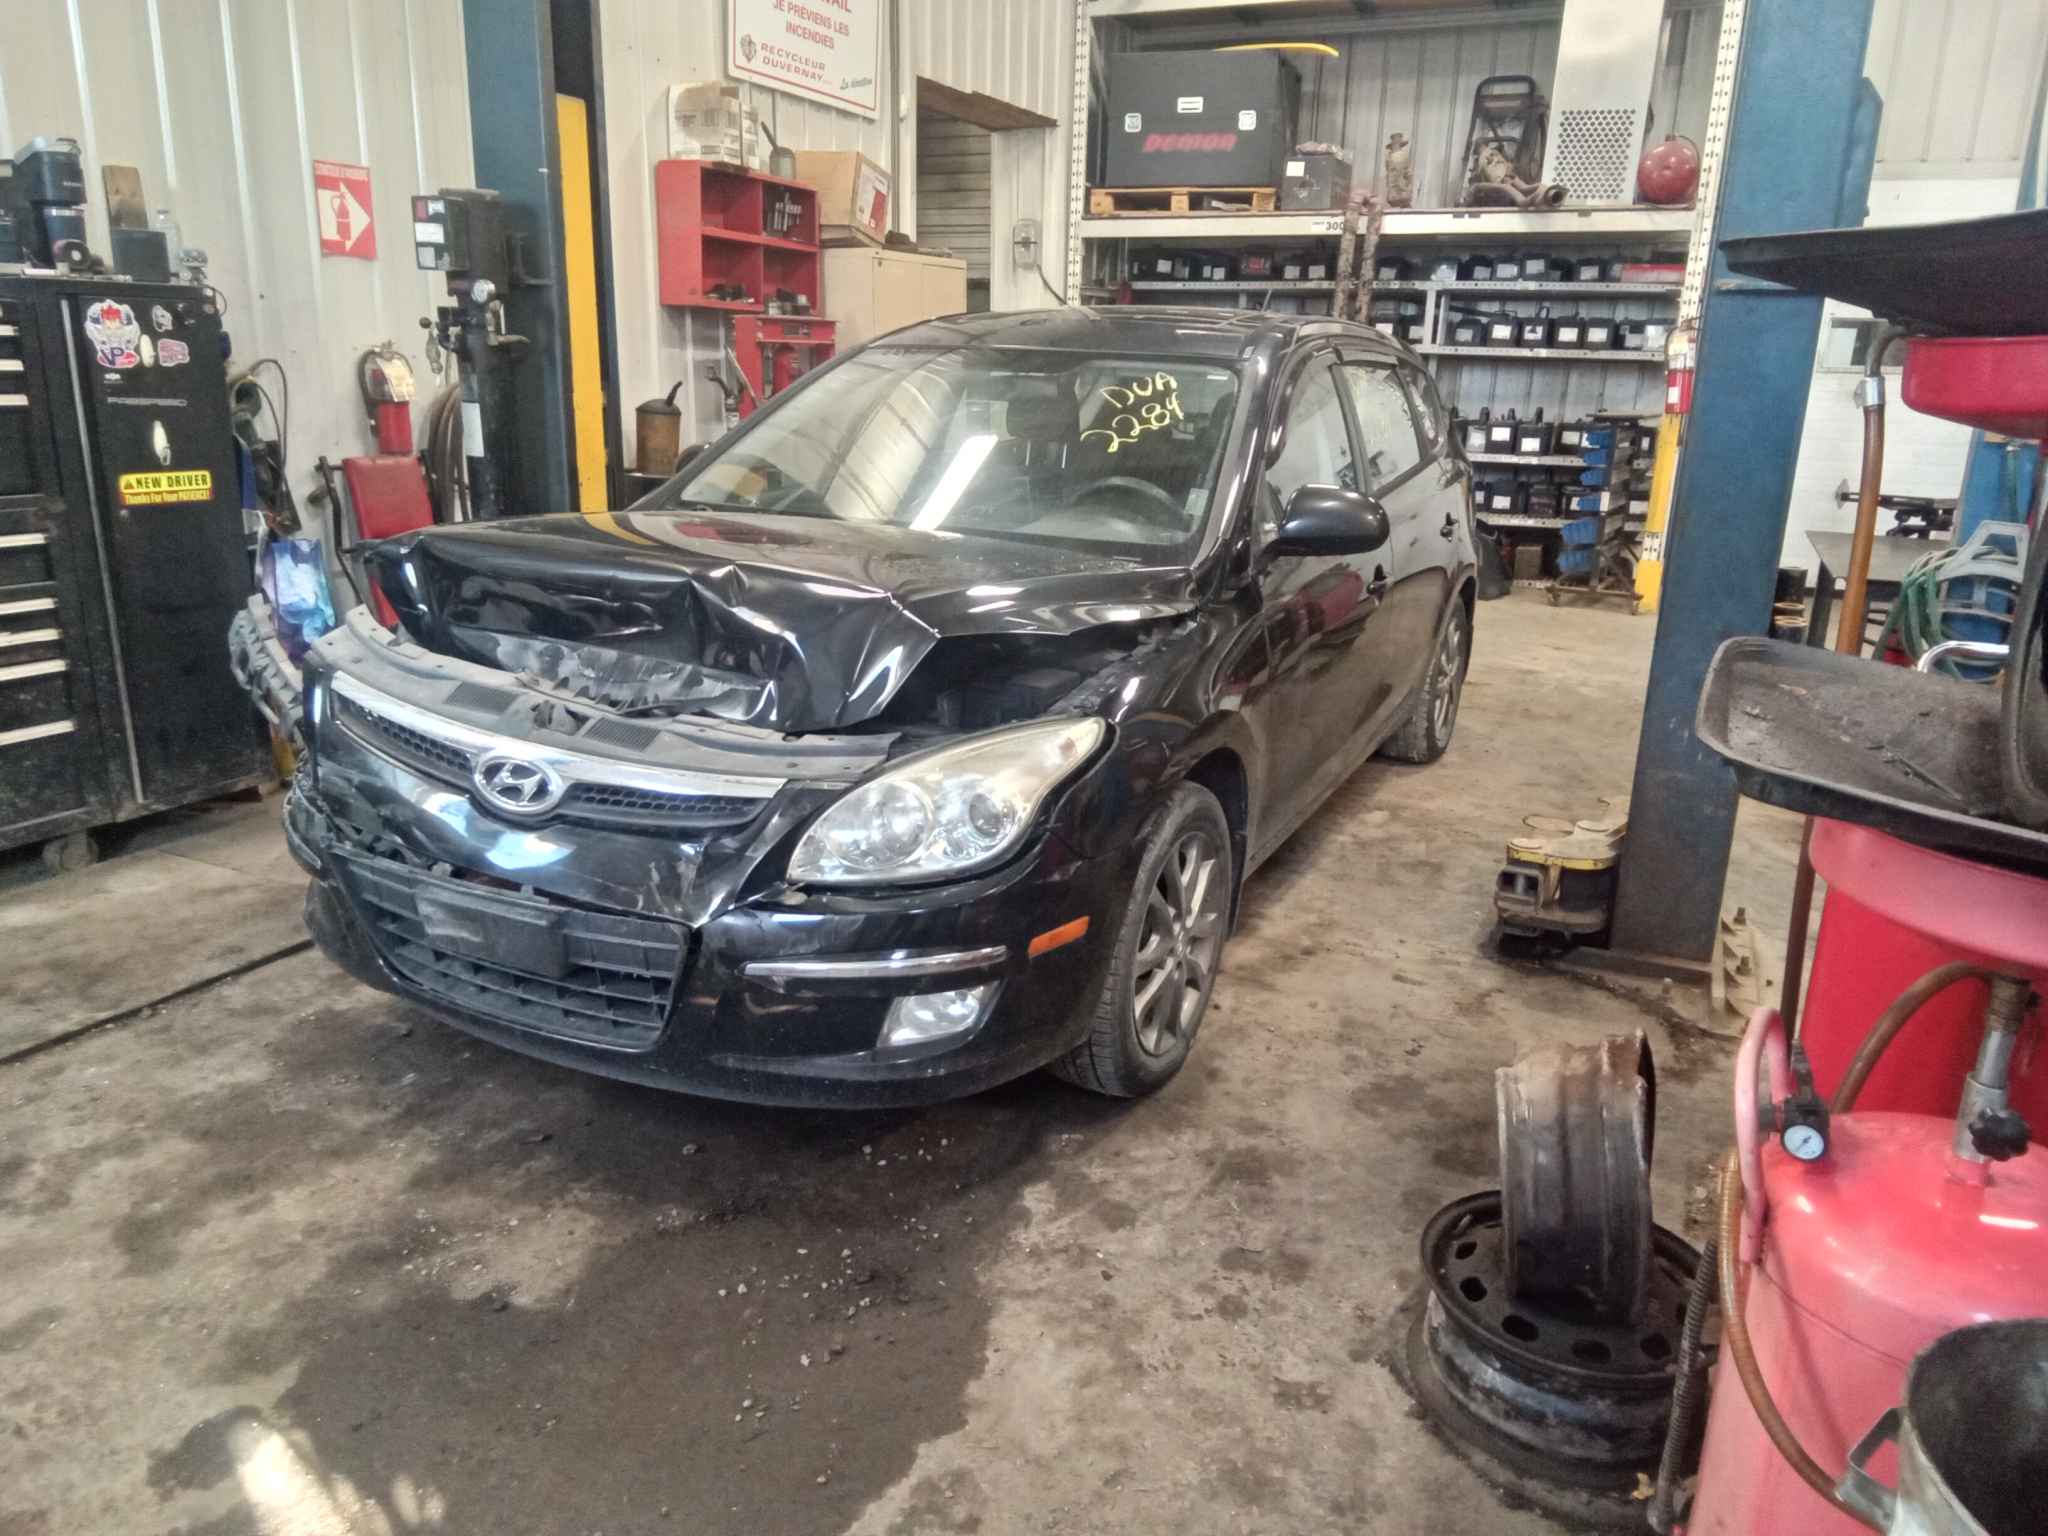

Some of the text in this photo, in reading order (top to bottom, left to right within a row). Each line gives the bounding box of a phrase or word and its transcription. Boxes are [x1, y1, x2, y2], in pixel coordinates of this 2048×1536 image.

[785, 21, 835, 49] INCENDIES
[833, 21, 849, 36] LES
[760, 43, 826, 71] RECYCLEUR
[762, 56, 825, 81] DUVERNAY
[1080, 391, 1184, 453] 2284
[135, 474, 208, 489] NEW DRIVER
